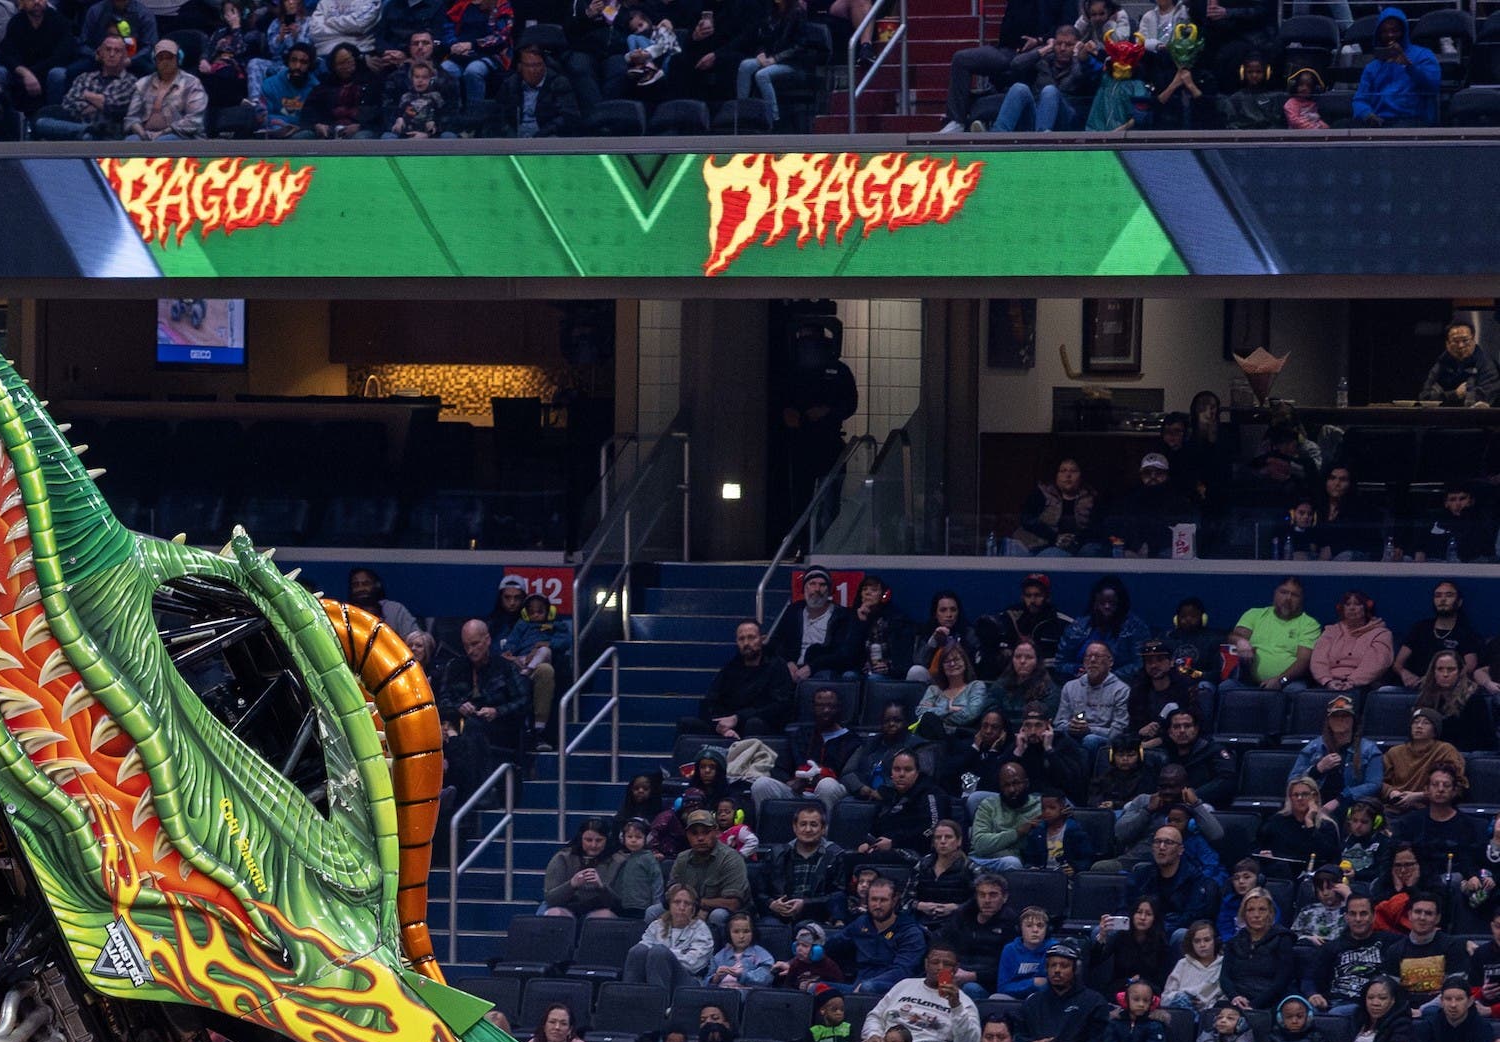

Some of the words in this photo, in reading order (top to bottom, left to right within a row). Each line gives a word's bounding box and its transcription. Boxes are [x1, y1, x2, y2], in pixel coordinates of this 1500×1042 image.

[97, 157, 317, 251] RAGON
[702, 152, 988, 276] DRAGON
[104, 920, 144, 987] MONSTER
[107, 943, 126, 976] JAM
[898, 996, 951, 1013] McLaren
